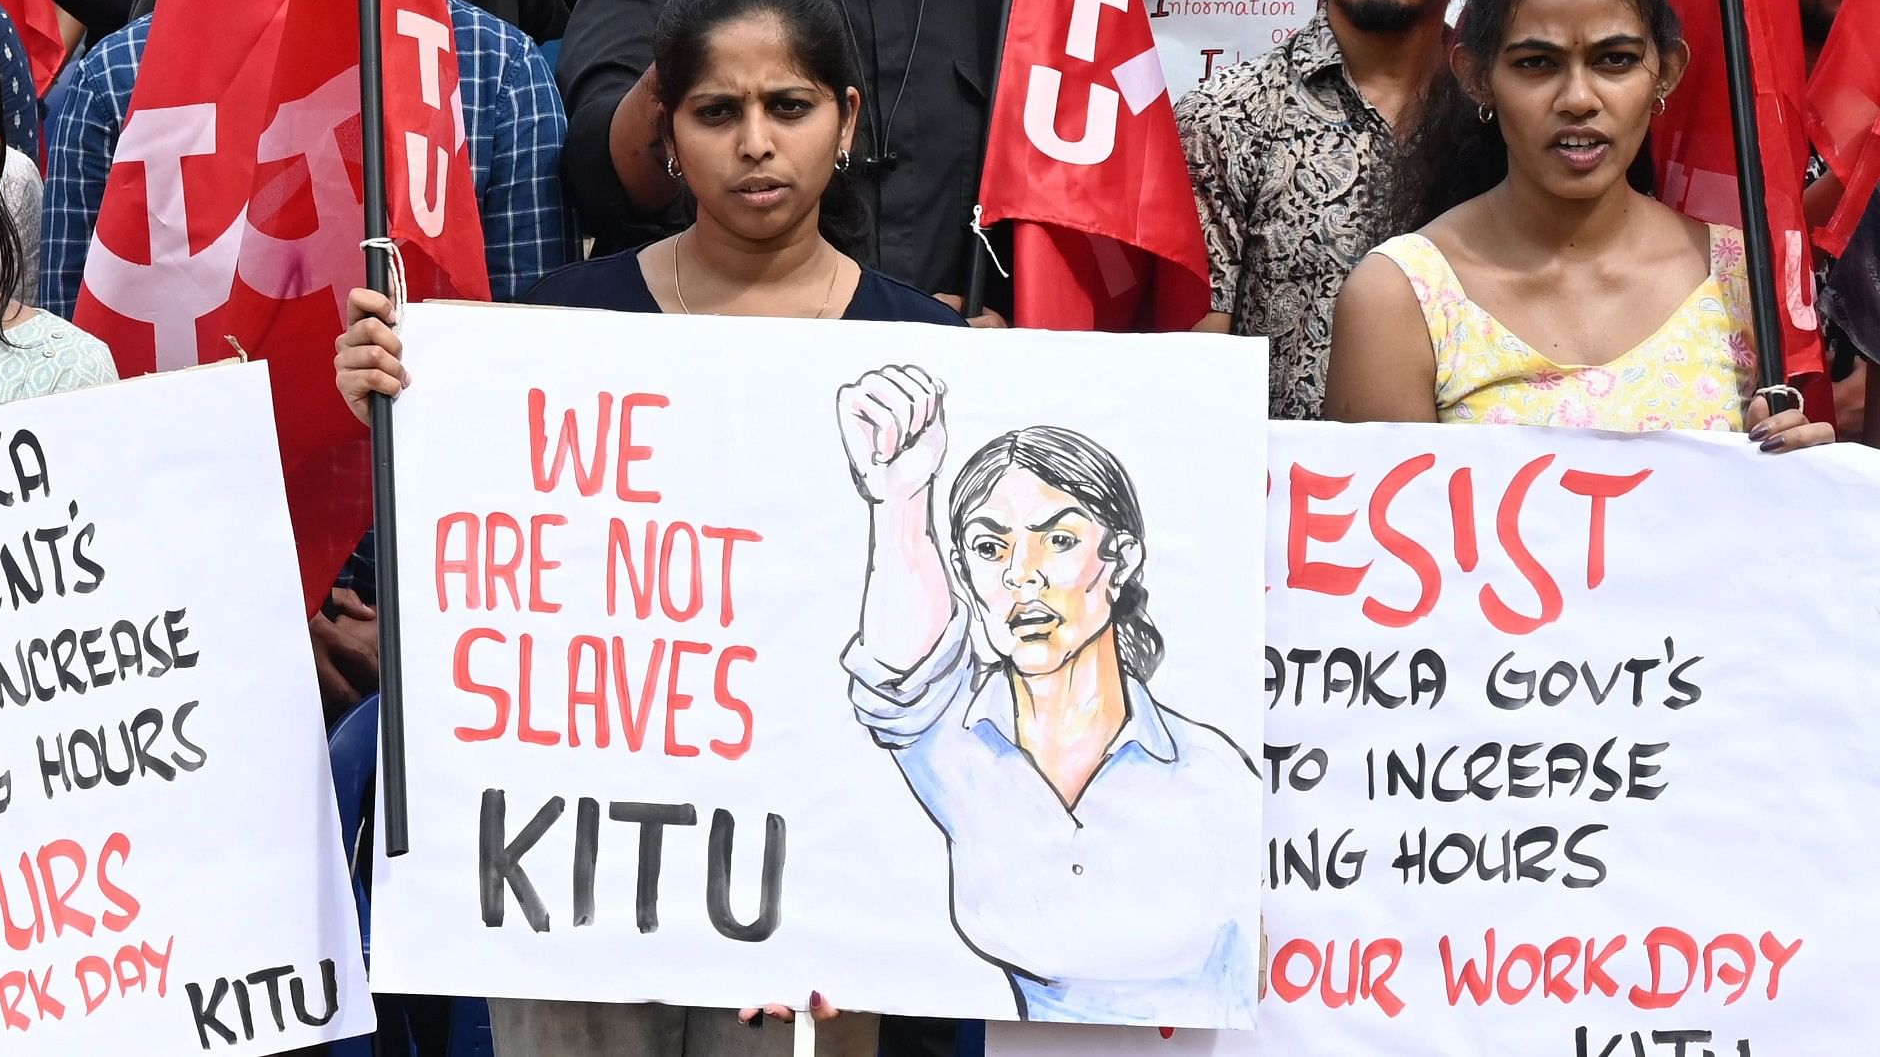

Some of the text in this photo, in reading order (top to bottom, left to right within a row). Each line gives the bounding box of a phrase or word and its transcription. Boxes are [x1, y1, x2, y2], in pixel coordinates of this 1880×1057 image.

[526, 388, 671, 505] WE
[434, 510, 764, 629] ARE NOT
[1266, 453, 1653, 635] ESIST
[451, 627, 759, 761] SLAVES
[1486, 634, 1704, 711] GOVT'S
[38, 700, 209, 796] HOURS
[1264, 737, 1671, 803] TO INCREASE
[478, 788, 789, 943] KITU
[1262, 823, 1609, 891] ING HOURS
[80, 935, 177, 1007] DAY
[185, 958, 339, 1051] KITU
[1261, 936, 1406, 1020] OUR
